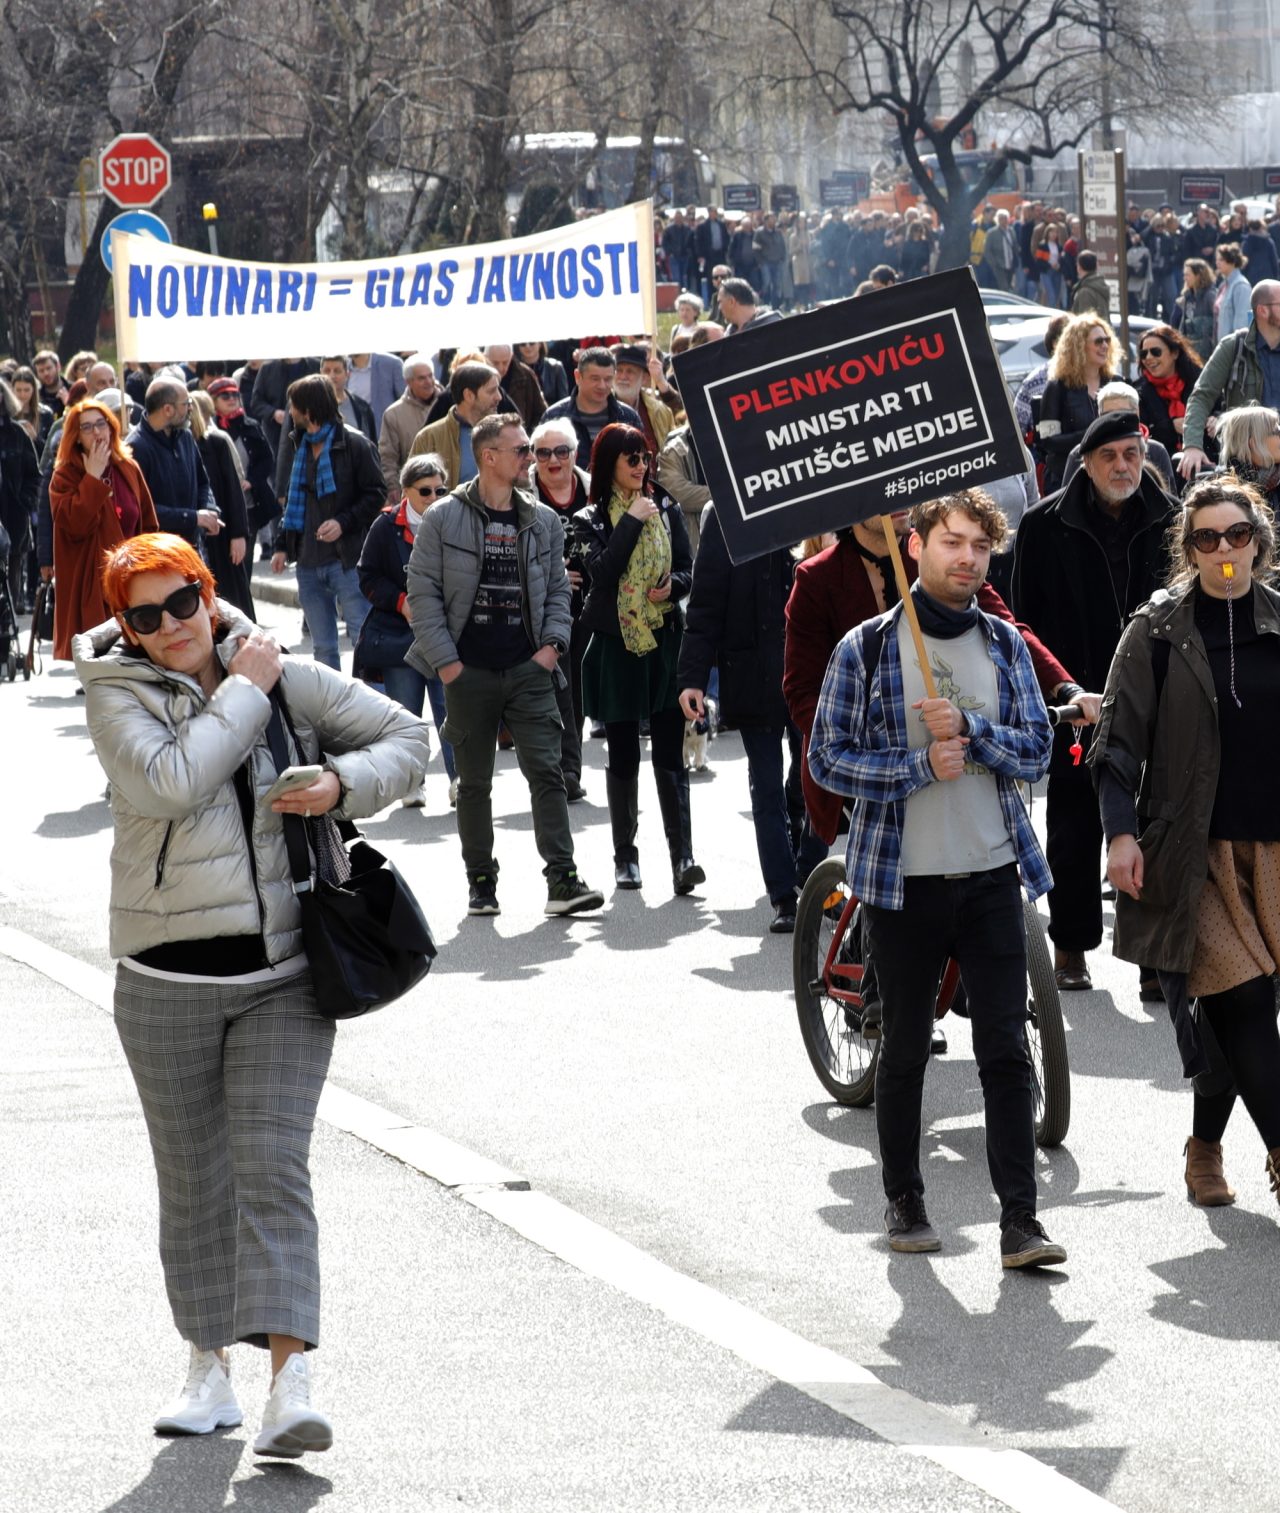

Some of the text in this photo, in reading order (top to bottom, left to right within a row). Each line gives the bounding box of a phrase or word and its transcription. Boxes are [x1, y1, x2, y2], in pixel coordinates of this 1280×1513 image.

[106, 157, 164, 186] STOP
[130, 265, 317, 318] NOVINARI
[365, 264, 458, 308] GLAS
[467, 239, 639, 306] JAVNOSTI
[730, 332, 945, 421] PLENKOVIĆU
[744, 407, 978, 498] PRITIŠĆE MEDIJE
[766, 381, 933, 451] MINISTAR TI
[884, 450, 997, 498] #špicpapak
